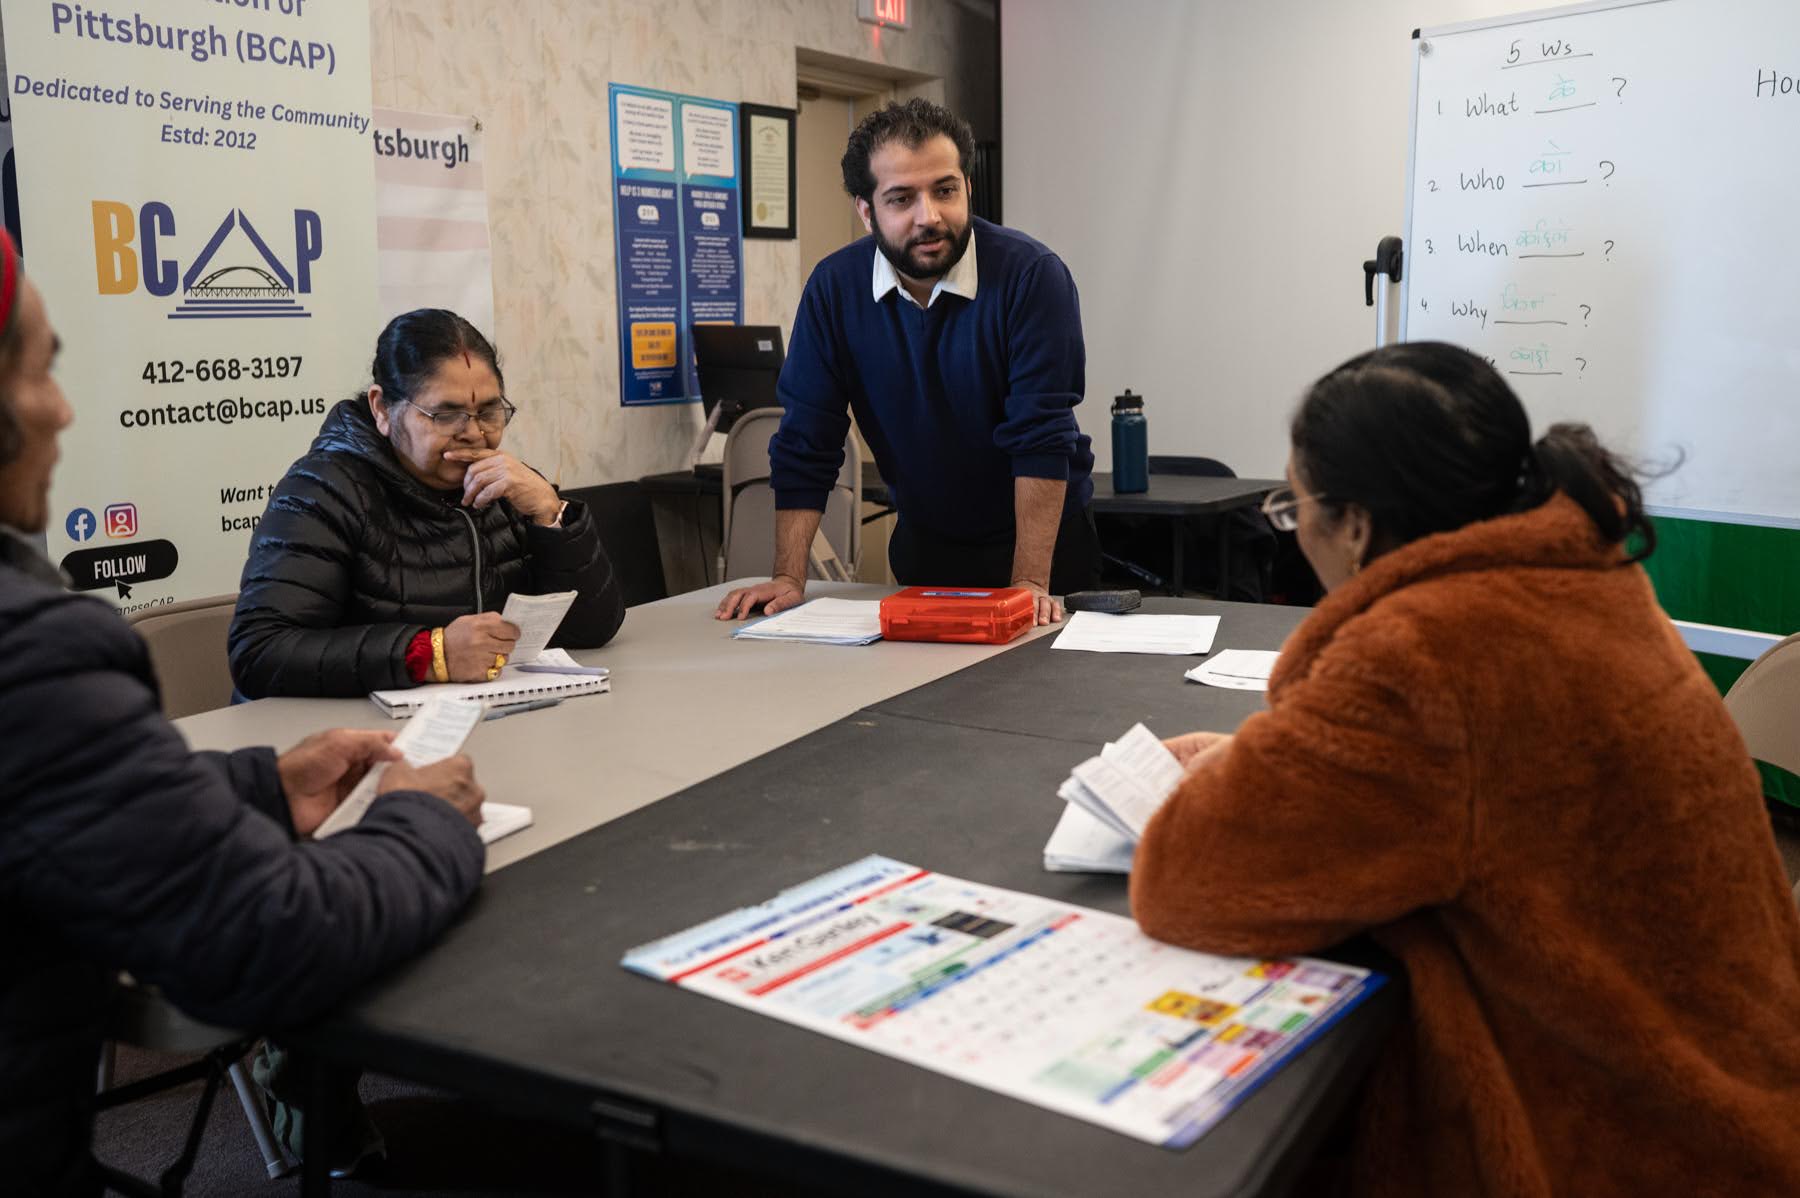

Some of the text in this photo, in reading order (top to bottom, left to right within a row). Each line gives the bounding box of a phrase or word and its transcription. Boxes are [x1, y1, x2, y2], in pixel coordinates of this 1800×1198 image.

[51, 3, 336, 75] Pittsburgh (BCAP)
[1507, 39, 1521, 63] 5
[14, 75, 370, 134] Dedicated to Serving the Community
[1466, 92, 1519, 117] What
[161, 125, 257, 150] Estd: 2012
[373, 128, 468, 169] tsburgh
[1460, 168, 1504, 190] Who
[1458, 230, 1508, 256] When
[1452, 299, 1487, 330] Why
[142, 356, 303, 384] 412-668-3197
[120, 396, 326, 428] contact@bcap.us
[220, 485, 264, 504] Want
[93, 555, 147, 579] FOLLOW
